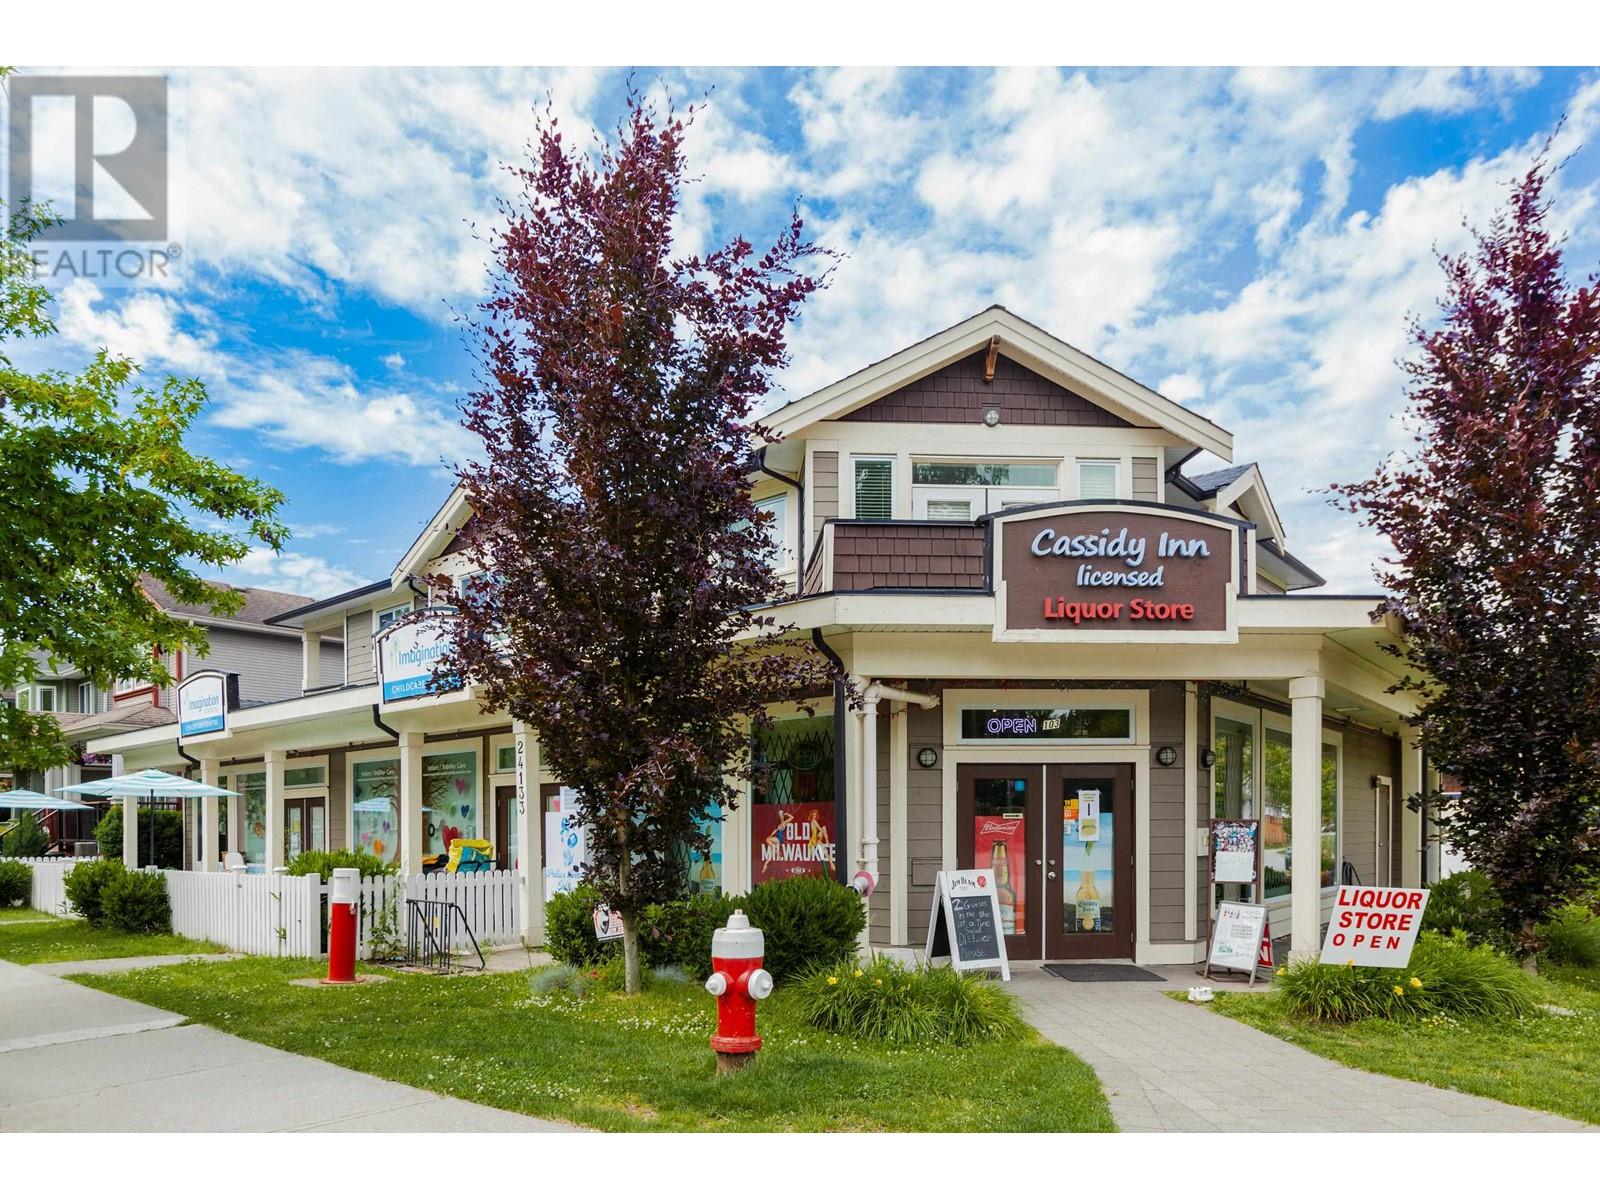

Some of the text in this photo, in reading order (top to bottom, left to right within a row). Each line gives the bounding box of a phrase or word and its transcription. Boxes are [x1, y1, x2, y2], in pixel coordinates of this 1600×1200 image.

[1031, 527, 1211, 567] Cassidy Inn
[1076, 564, 1165, 587] licensed
[1043, 596, 1195, 625] Liquor Store
[987, 718, 1037, 734] OPEN
[1043, 720, 1060, 729] 103
[517, 740, 525, 815] 24133
[786, 822, 811, 841] OLD
[761, 843, 836, 862] MILWAUKEE
[952, 899, 964, 911] 2
[1338, 889, 1423, 910] LIQUOR
[1339, 911, 1414, 931] STORE
[1332, 933, 1401, 950] OPEN
